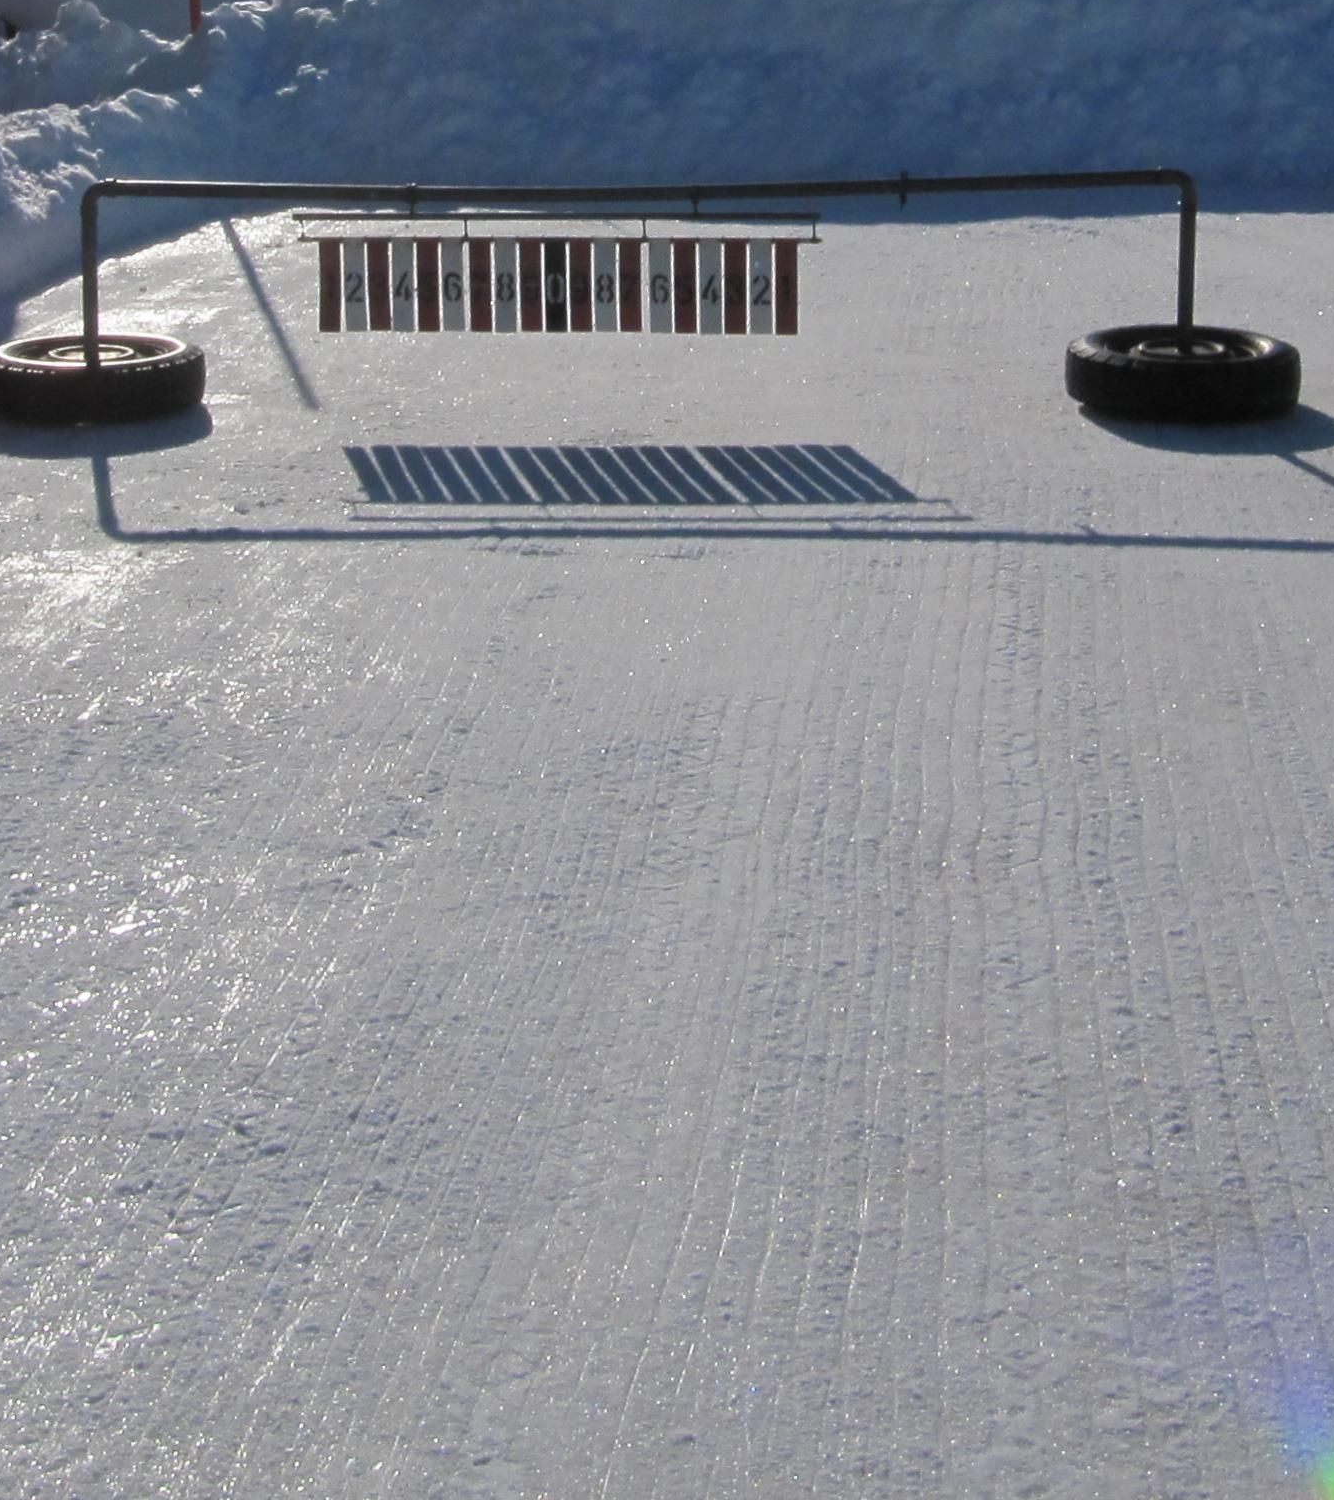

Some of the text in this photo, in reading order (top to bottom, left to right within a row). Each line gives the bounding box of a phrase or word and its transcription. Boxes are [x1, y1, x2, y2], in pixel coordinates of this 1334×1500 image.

[345, 273, 363, 303] 2
[394, 273, 412, 303] 4
[444, 272, 462, 303] 6
[496, 273, 514, 302] 8
[546, 273, 565, 304] 0
[596, 274, 614, 303] 8
[652, 274, 670, 304] 6
[701, 274, 718, 304] 4
[753, 275, 771, 304] 2
